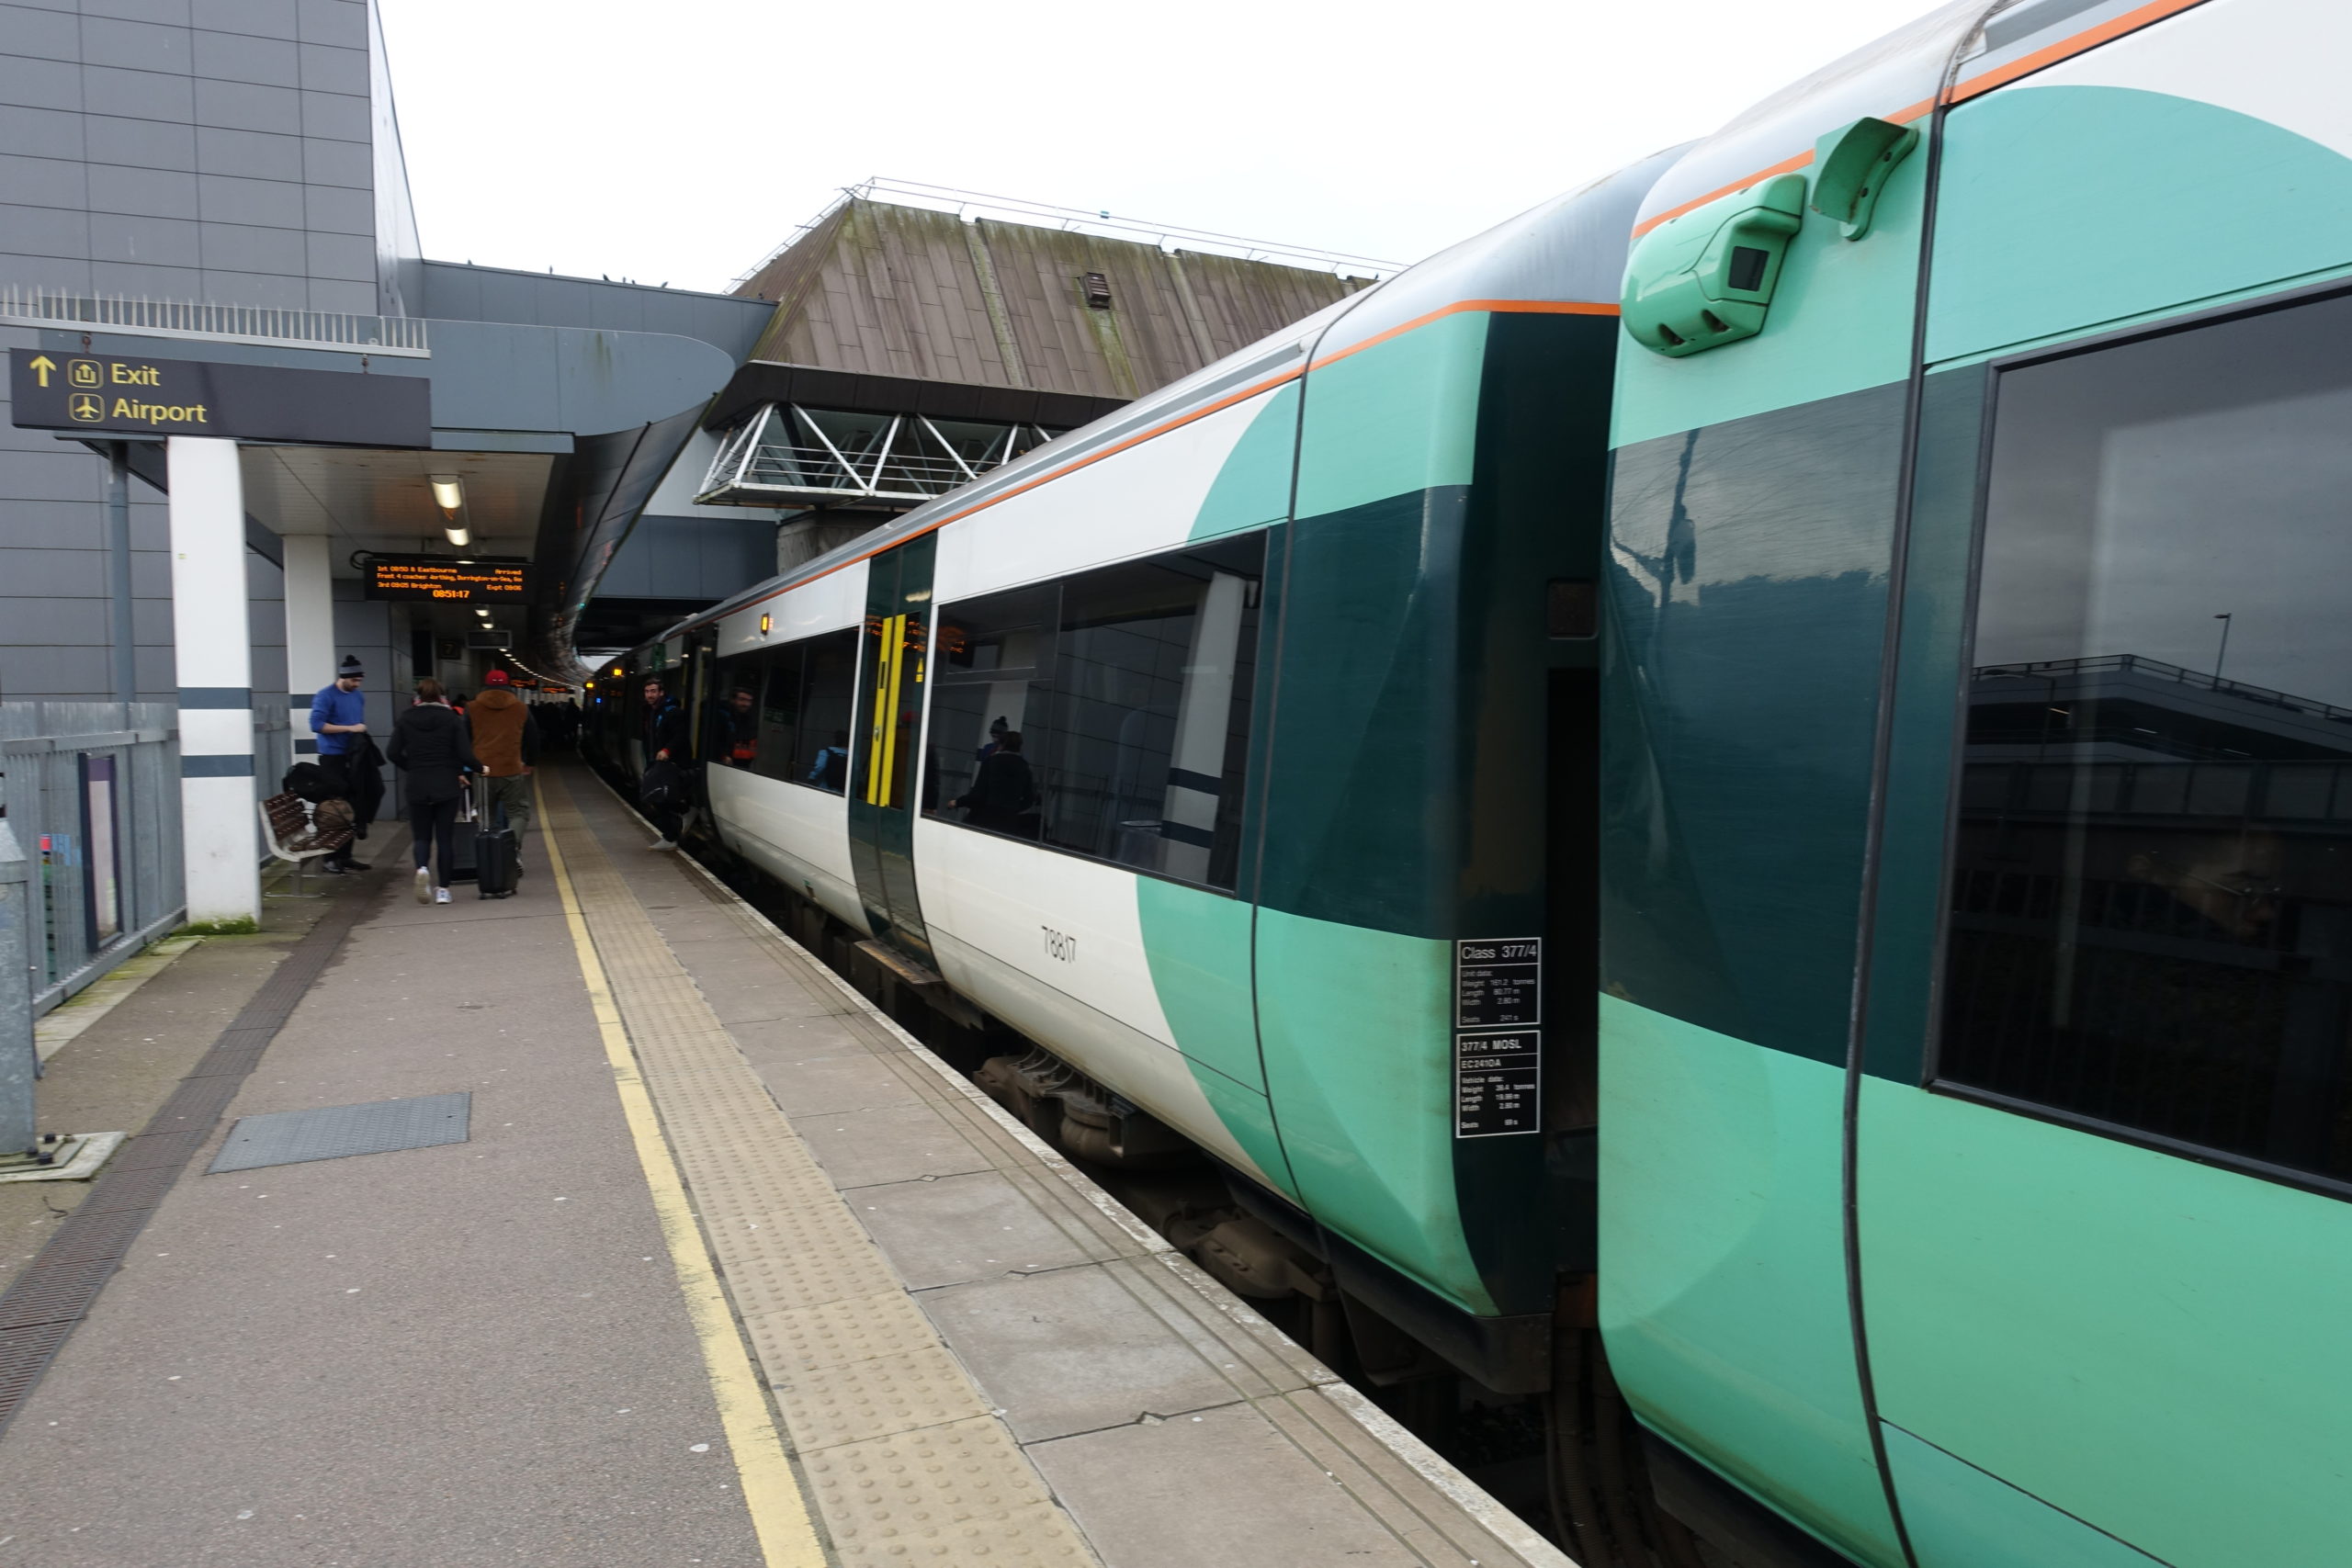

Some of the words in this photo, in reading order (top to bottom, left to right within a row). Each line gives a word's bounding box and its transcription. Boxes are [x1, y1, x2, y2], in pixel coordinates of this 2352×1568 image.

[111, 363, 161, 387] Exit
[112, 398, 208, 425] Airport
[417, 566, 458, 574] Eastbourne
[1041, 925, 1076, 964] 78817
[1462, 946, 1496, 959] Class
[1501, 944, 1537, 958] 377/4
[1462, 980, 1485, 988] Weight
[1462, 989, 1485, 998] Length
[1461, 1041, 1488, 1052] 377/4
[1462, 1086, 1485, 1094] Weight
[1462, 1095, 1483, 1103] Length
